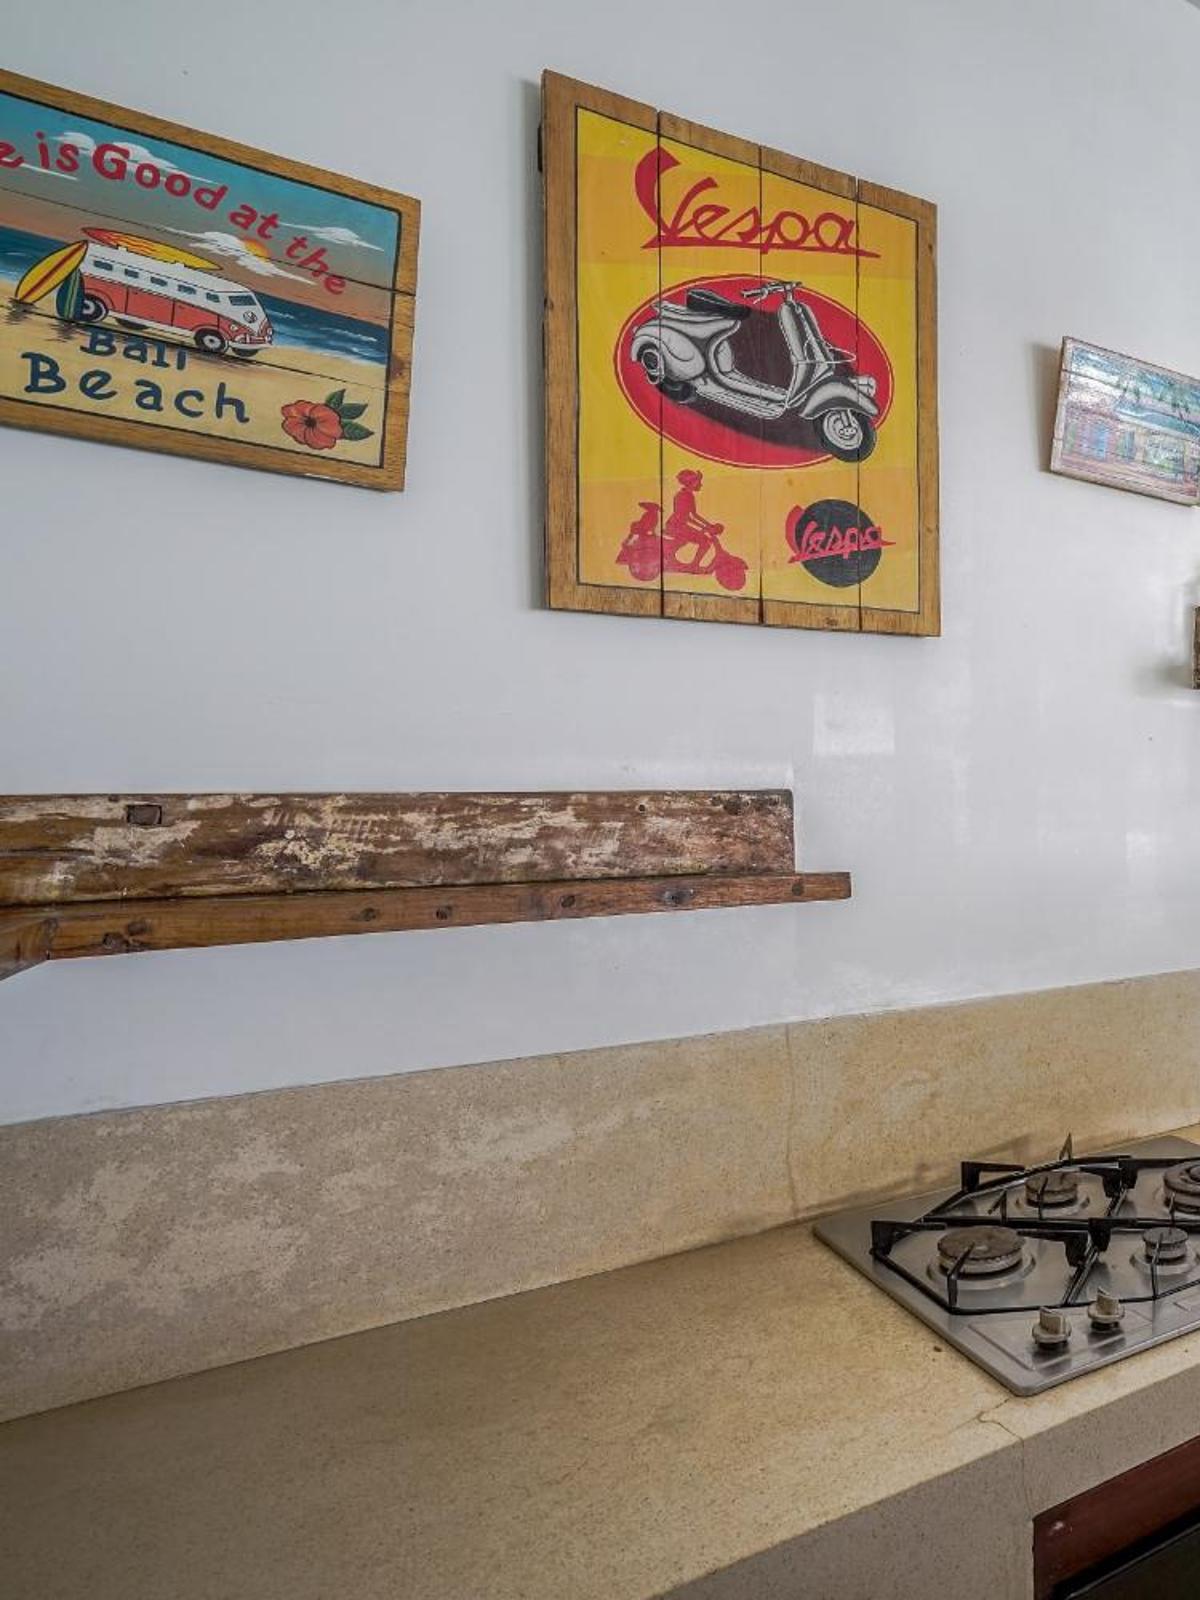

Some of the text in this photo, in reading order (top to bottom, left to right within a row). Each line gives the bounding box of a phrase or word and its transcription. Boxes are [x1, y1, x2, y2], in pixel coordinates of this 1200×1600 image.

[35, 131, 79, 172] is
[92, 143, 228, 210] Good
[229, 203, 280, 240] at
[284, 236, 347, 295] the
[634, 146, 880, 258] Vespa
[80, 329, 187, 371] Bali
[21, 351, 250, 423] Beach
[785, 504, 896, 563] Vespa
